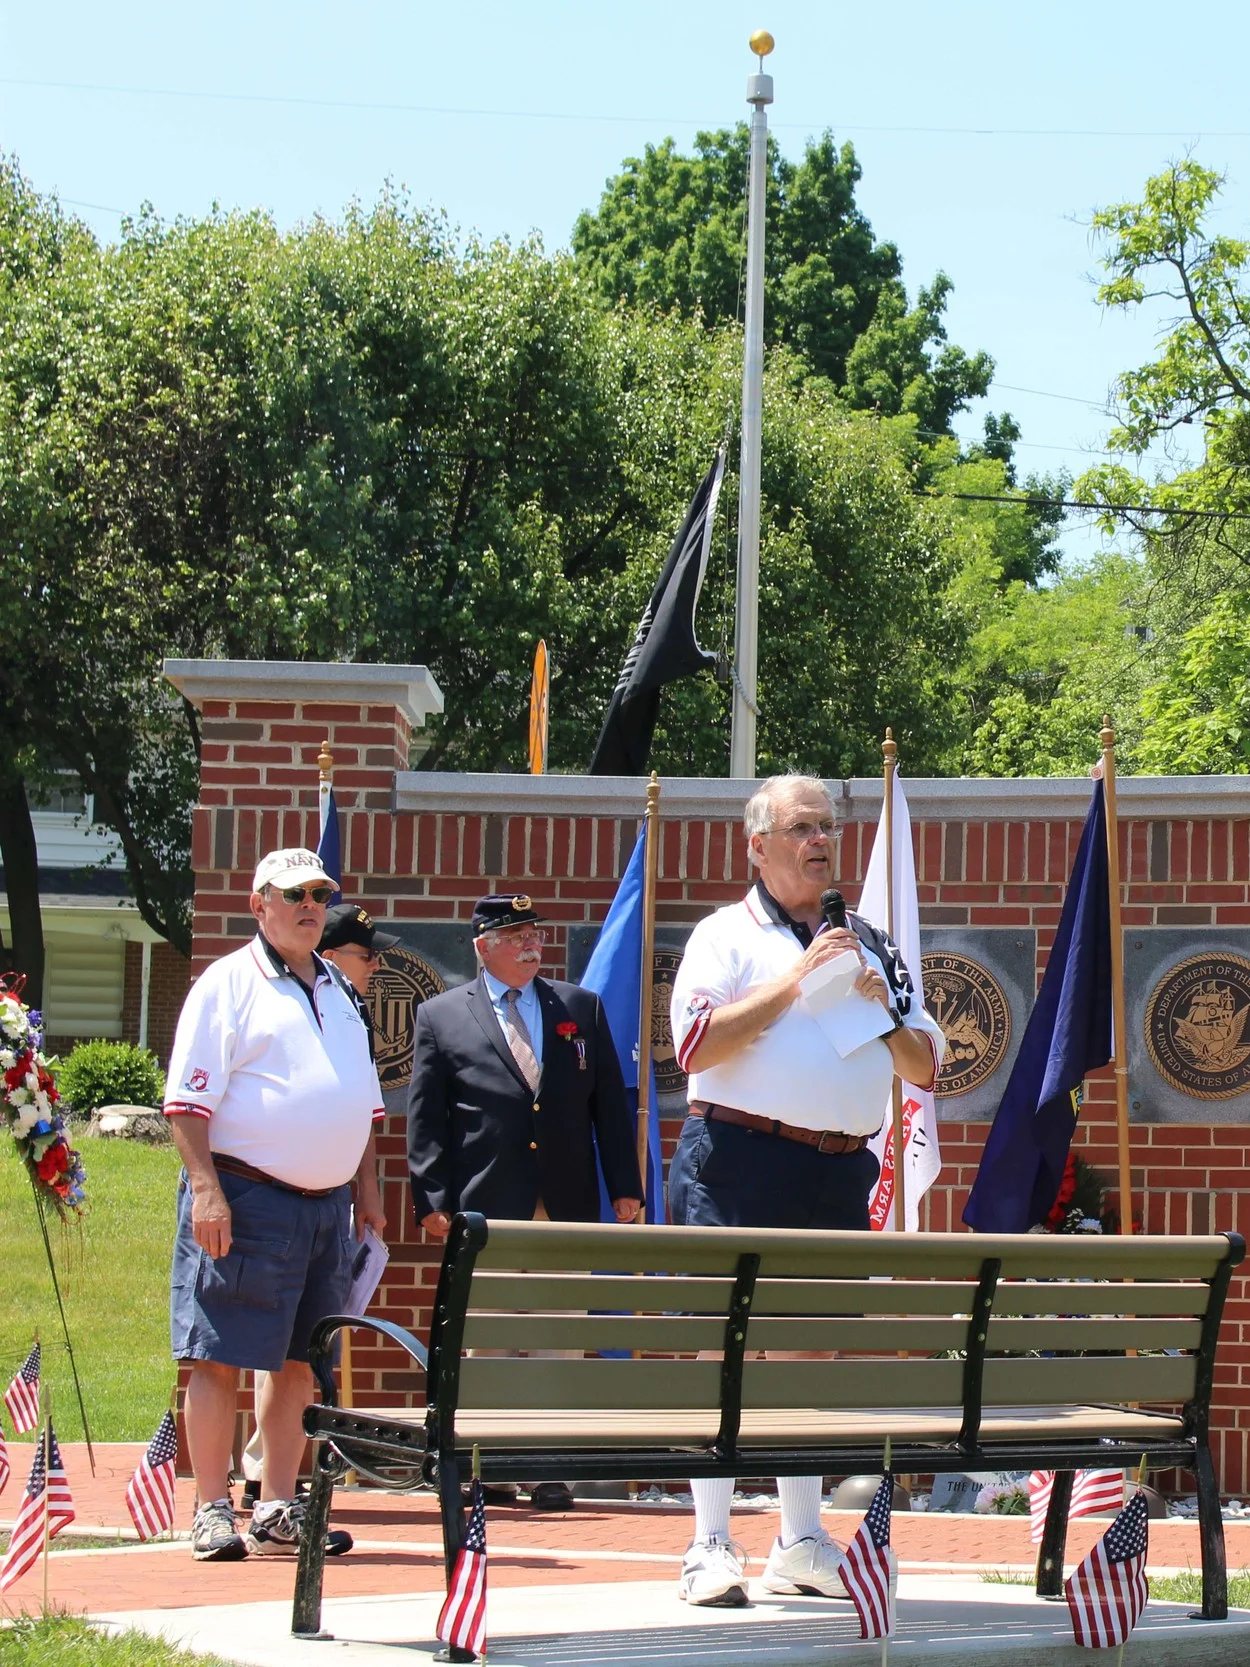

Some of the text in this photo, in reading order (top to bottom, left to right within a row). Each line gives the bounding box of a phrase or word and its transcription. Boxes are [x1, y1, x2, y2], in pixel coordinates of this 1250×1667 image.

[284, 855, 322, 869] NAVY
[943, 959, 958, 970] OF
[963, 965, 987, 986] THE
[985, 986, 1005, 1024] ARMY
[1157, 965, 1214, 1017] DEPARTMENT
[1216, 965, 1231, 976] OF
[952, 1029, 1004, 1089] OF AMERICA
[1157, 1033, 1182, 1072] UNITED
[1181, 1069, 1222, 1087] STATES
[1225, 1075, 1240, 1085] OF
[947, 1481, 967, 1492] THE
